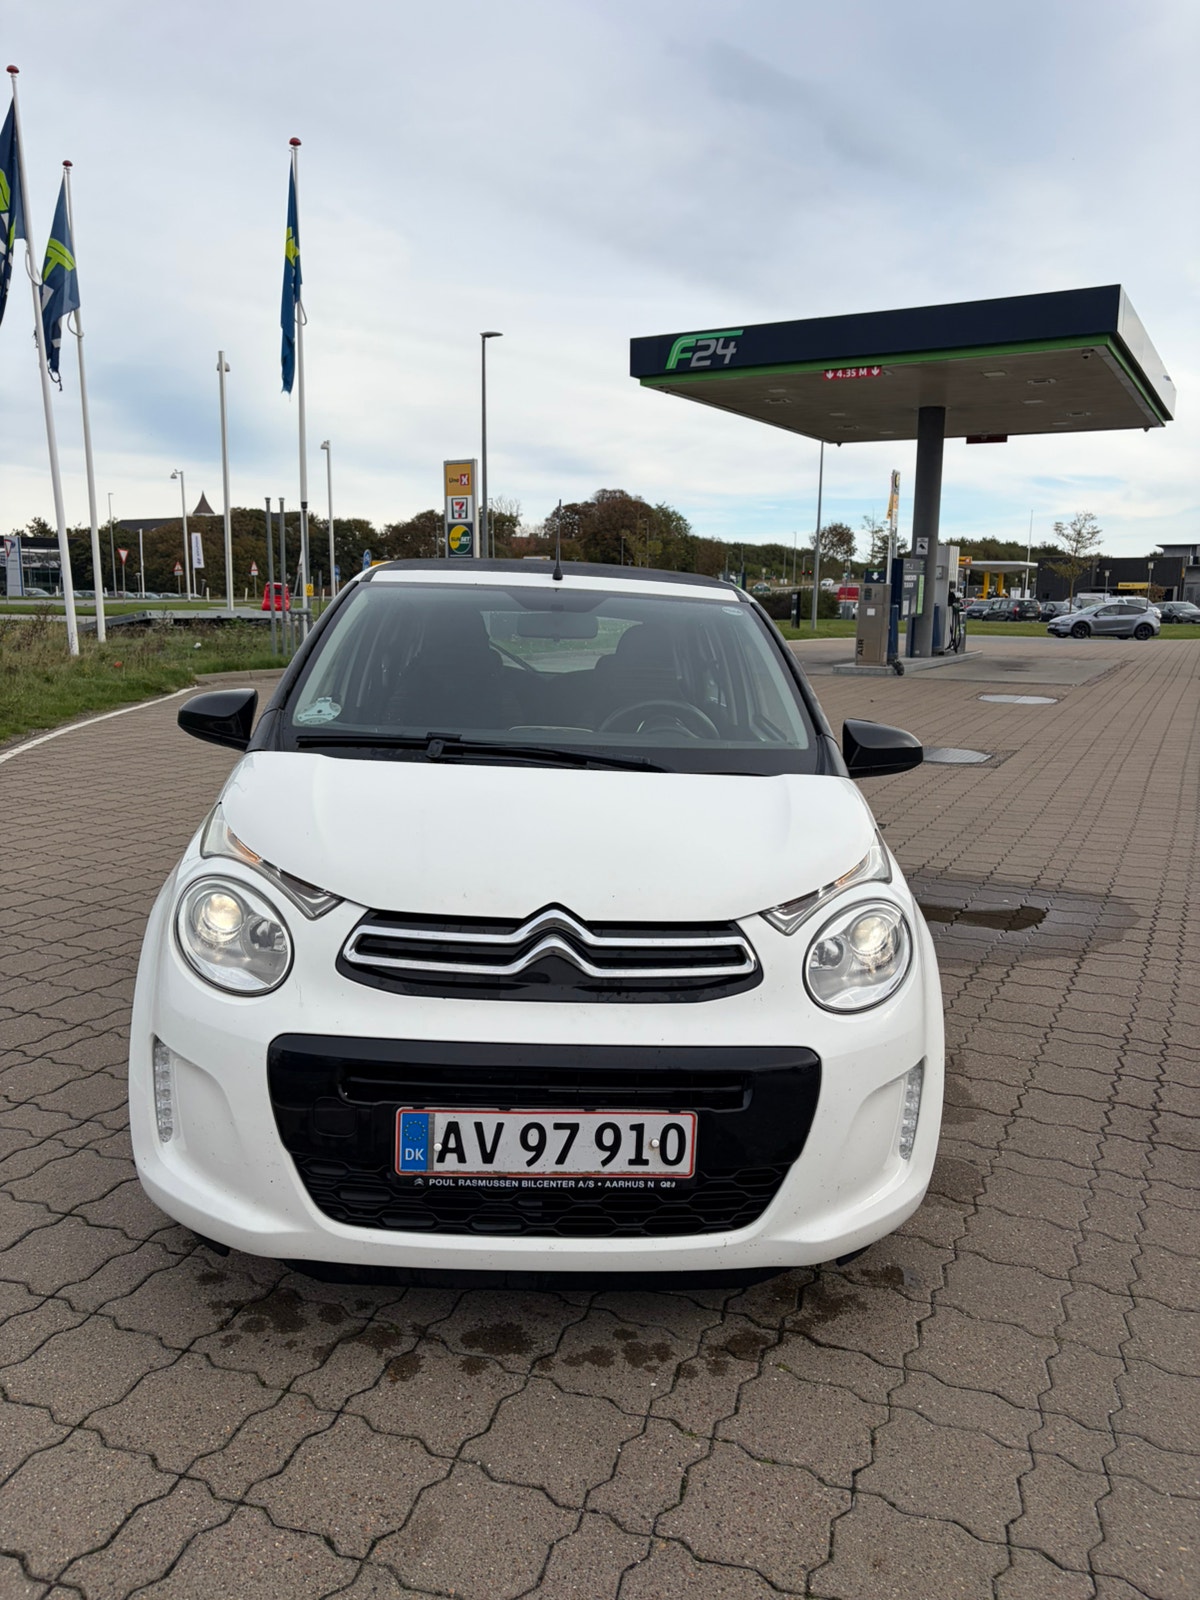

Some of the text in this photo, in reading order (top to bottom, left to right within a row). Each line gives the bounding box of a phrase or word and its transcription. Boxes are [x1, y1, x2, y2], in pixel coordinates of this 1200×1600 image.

[665, 329, 744, 370] F24
[836, 367, 868, 378] 4.35 M
[454, 501, 465, 518] 7
[436, 1121, 687, 1168] AV 97 910
[404, 1148, 425, 1161] DK
[428, 1178, 455, 1186] POUL
[458, 1179, 519, 1187] RASMUSSEN
[521, 1180, 575, 1188] BILCENTER
[578, 1180, 595, 1188] A/S
[605, 1180, 645, 1188] AARHUS
[647, 1180, 655, 1188] N
